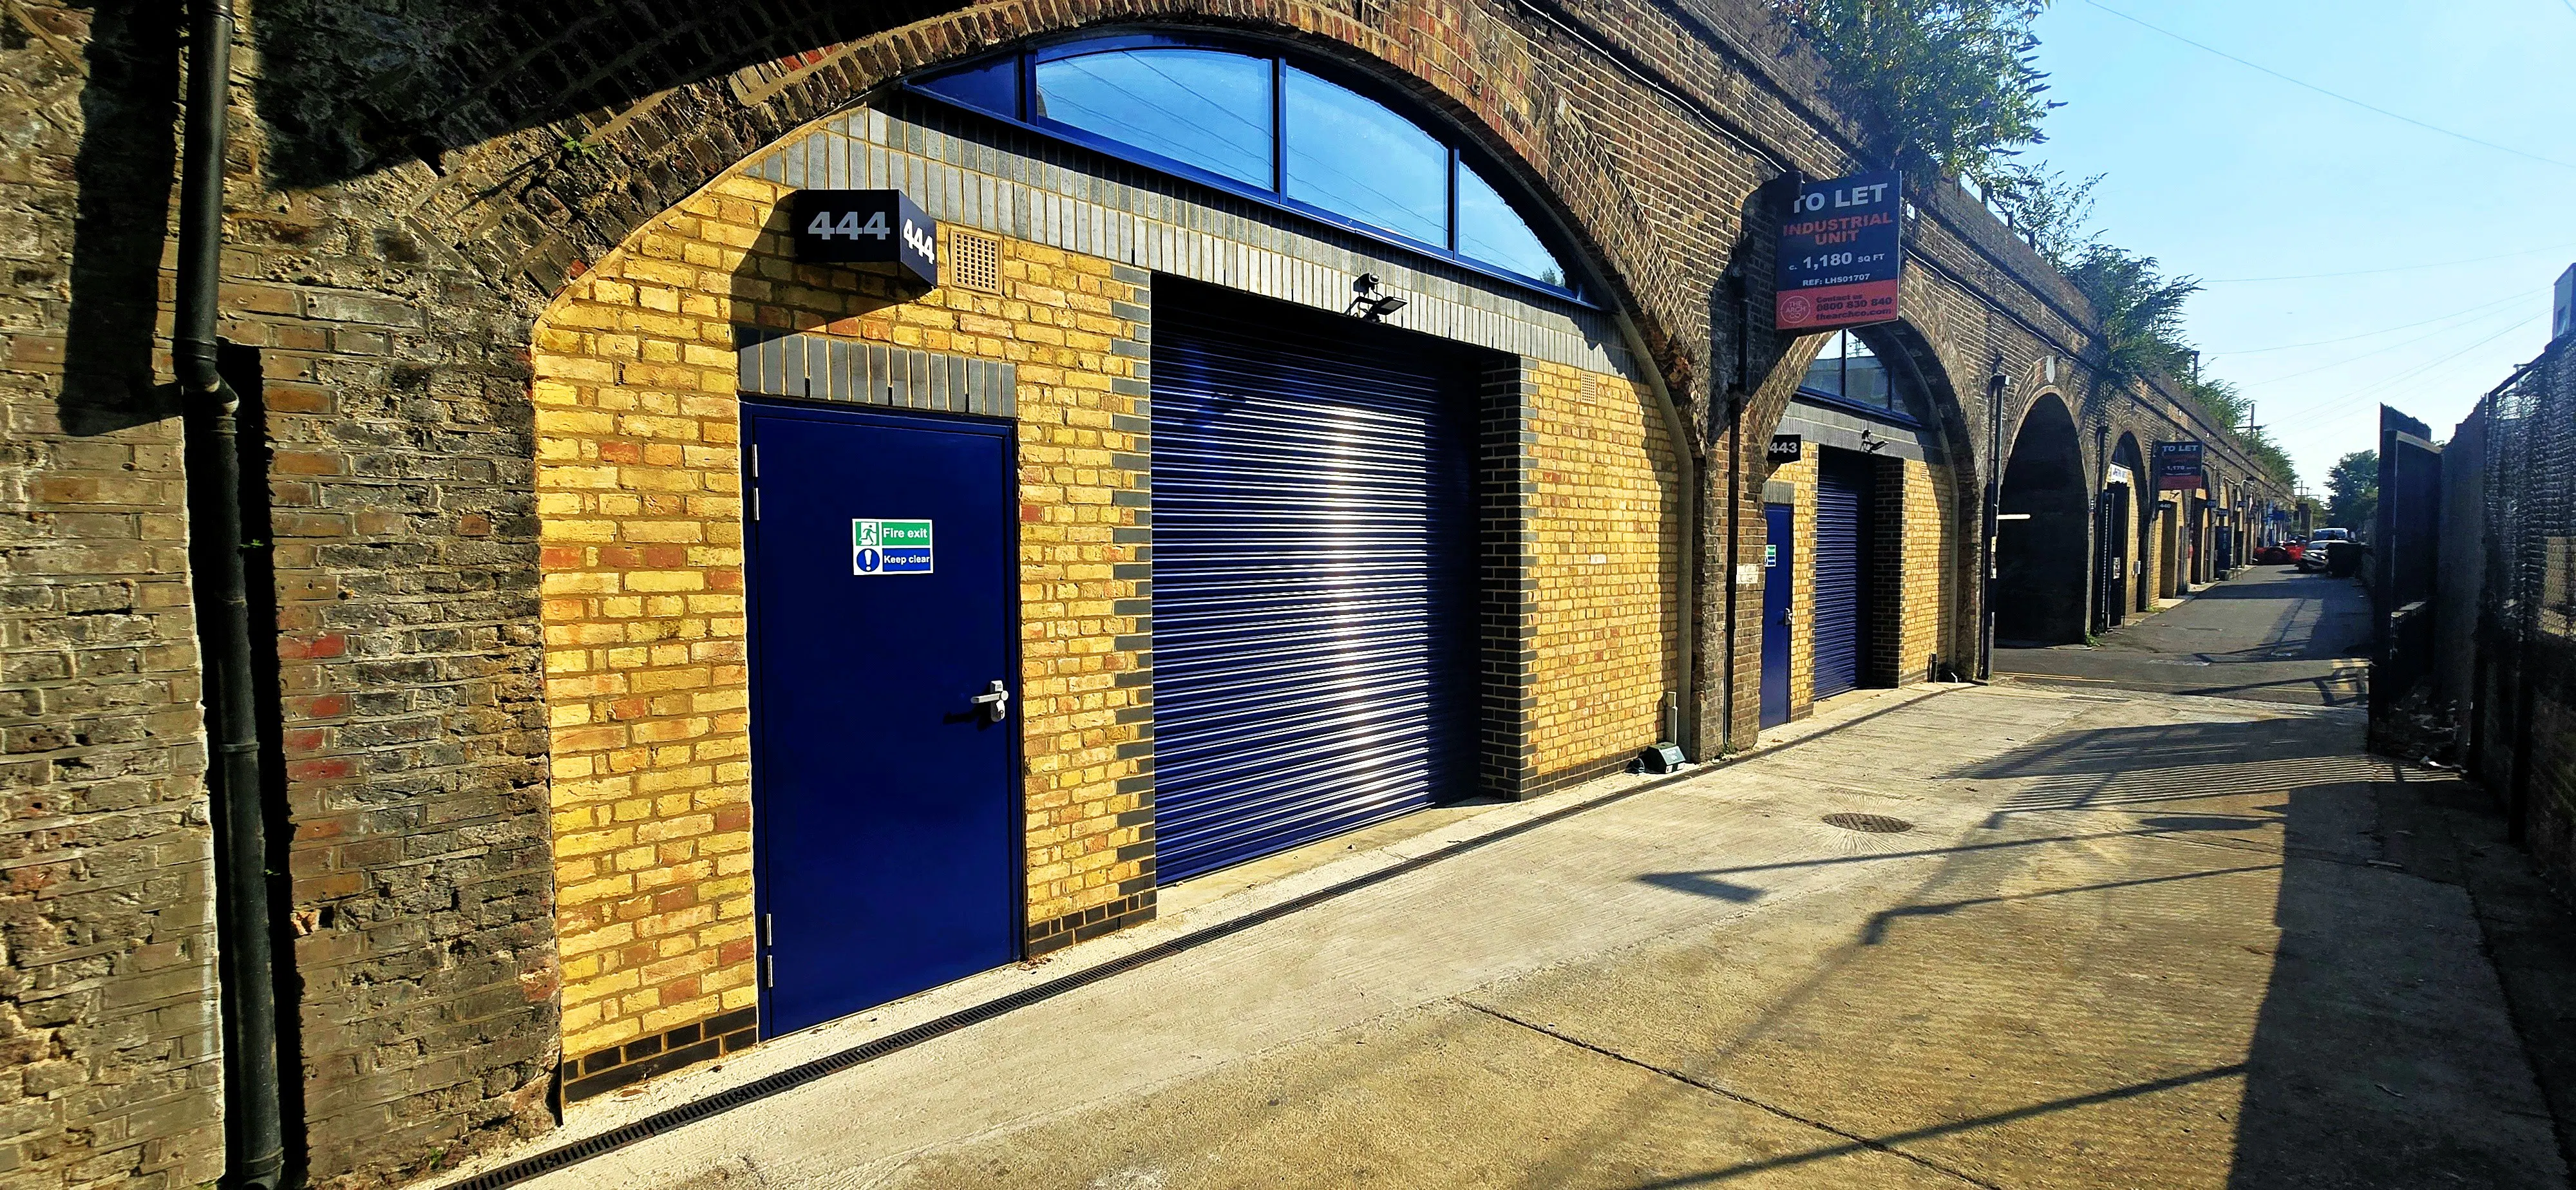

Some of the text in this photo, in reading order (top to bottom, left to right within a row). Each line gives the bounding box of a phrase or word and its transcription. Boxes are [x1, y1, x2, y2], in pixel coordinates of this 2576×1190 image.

[1794, 183, 1888, 213] TO LET
[808, 211, 890, 240] 444
[1783, 212, 1893, 236] INDUSTRIAL
[903, 218, 935, 265] 444
[1815, 229, 1859, 245] UNIT
[1803, 252, 1852, 270] 1,180
[1873, 253, 1885, 261] FT
[1825, 274, 1870, 284] LHS01707
[1816, 294, 1851, 303] Contact
[1817, 297, 1893, 312] 0800 830 840
[1816, 308, 1892, 321] thearchco.com
[1769, 442, 1797, 453] 443
[883, 527, 928, 538] Fire exit
[884, 554, 930, 565] Keep clear
